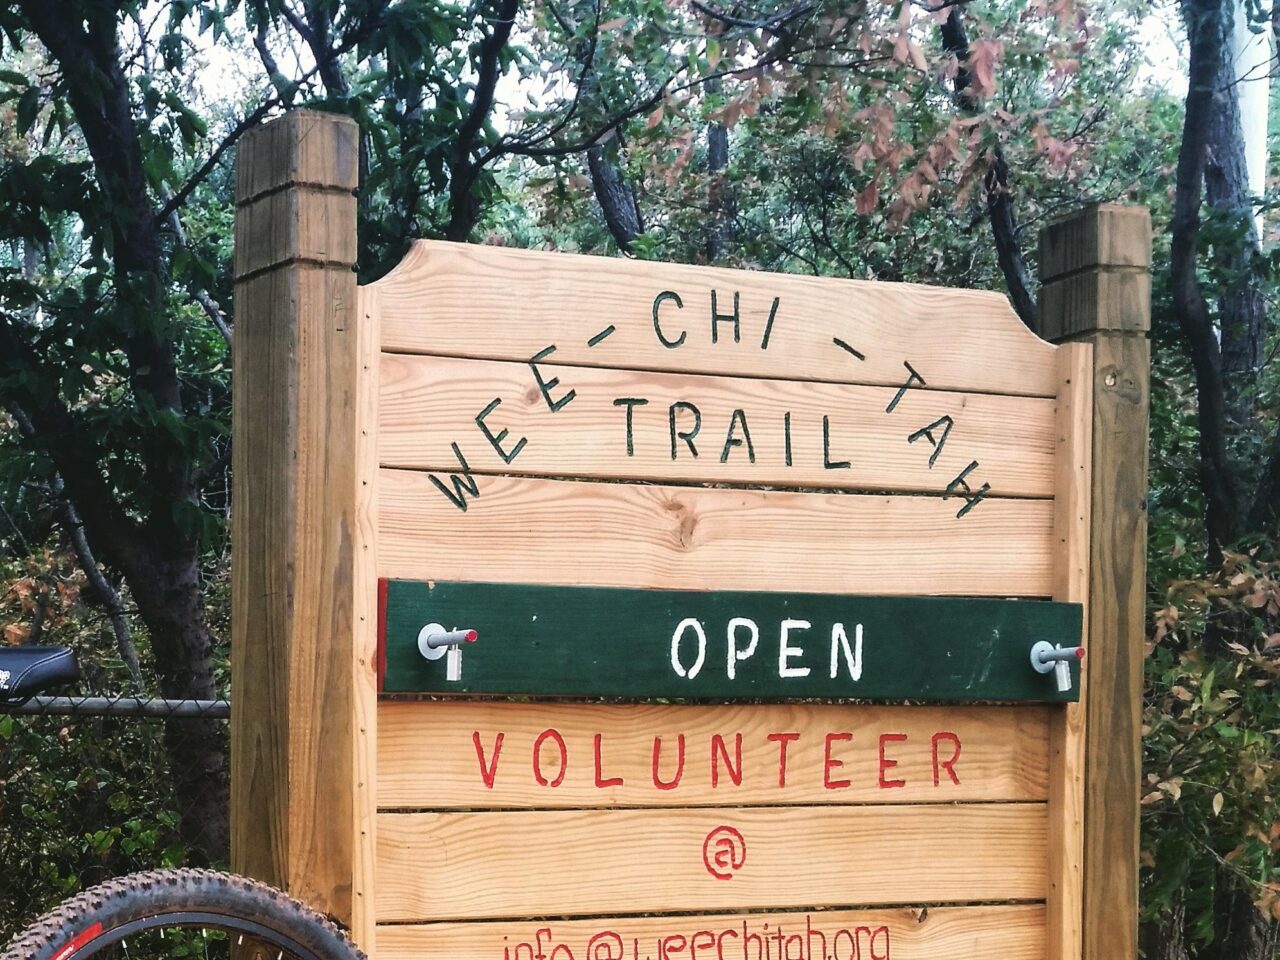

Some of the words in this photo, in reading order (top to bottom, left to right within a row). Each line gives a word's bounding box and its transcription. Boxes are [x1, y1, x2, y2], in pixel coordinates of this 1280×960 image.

[613, 397, 852, 470] TRAIL
[670, 617, 864, 680] OPEN
[473, 728, 962, 789] VOLUNTEER
[702, 825, 747, 880] @
